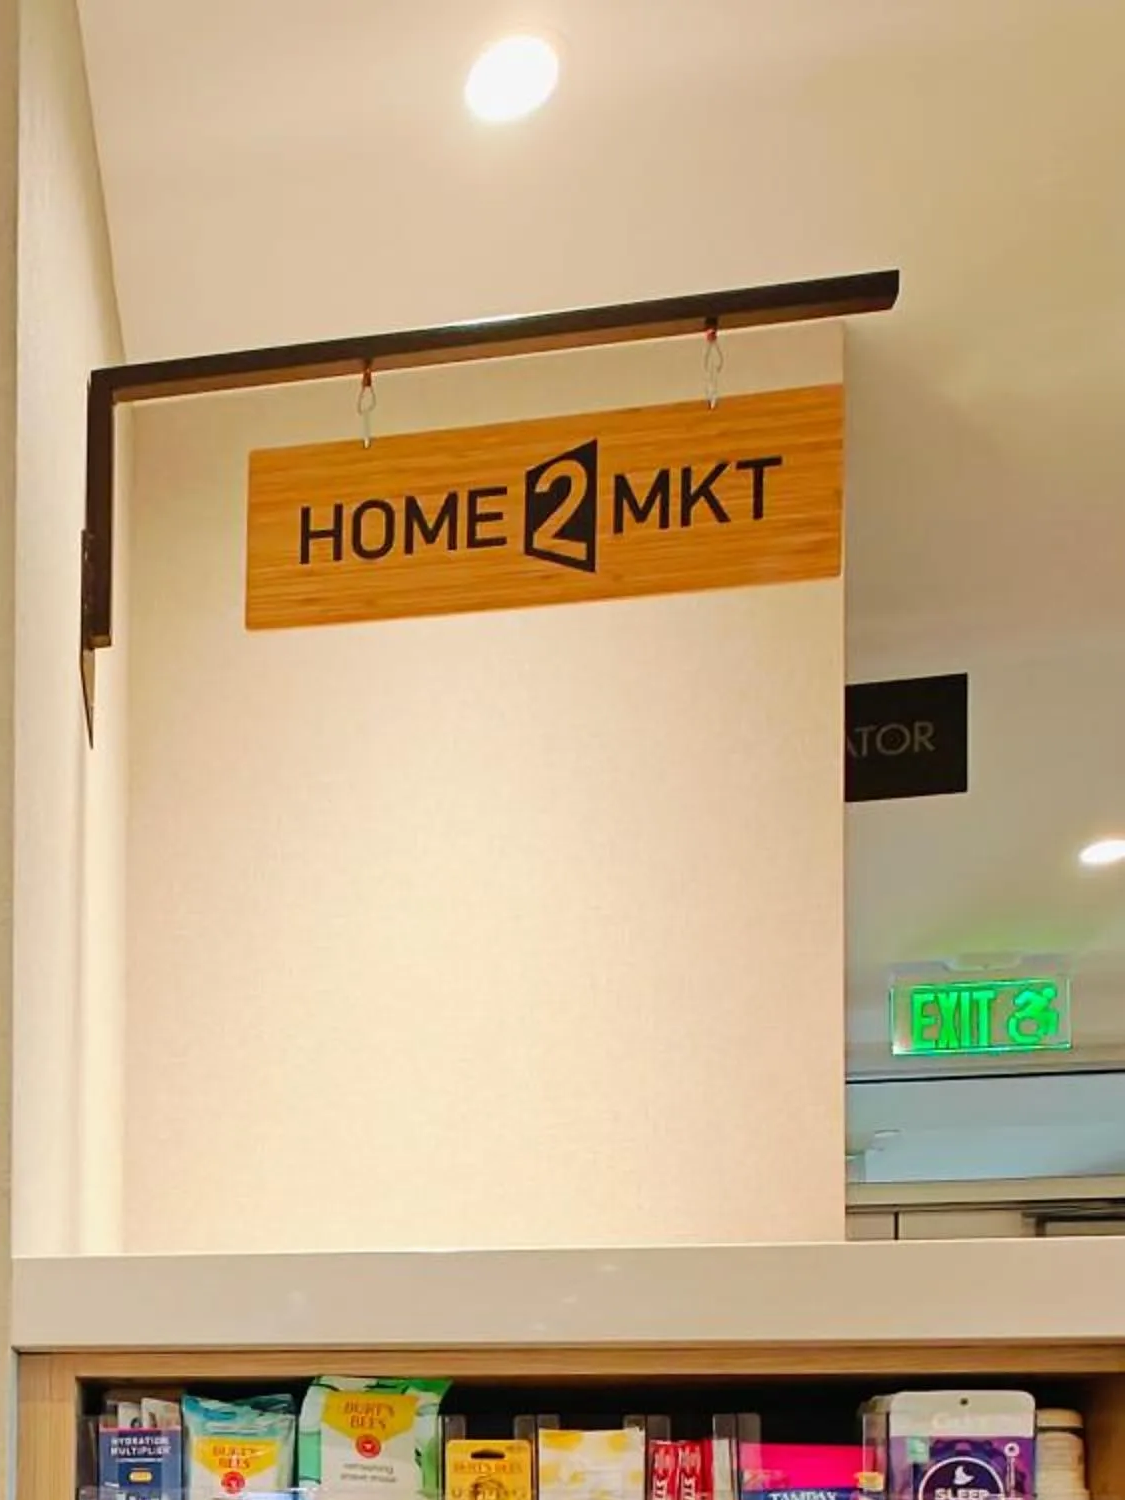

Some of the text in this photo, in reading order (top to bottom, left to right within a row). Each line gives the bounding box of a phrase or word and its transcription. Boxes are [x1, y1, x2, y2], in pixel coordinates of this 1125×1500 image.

[299, 450, 783, 566] HOME 2 MKT
[910, 989, 996, 1050] EXIT
[111, 1436, 171, 1446] HYDRATION
